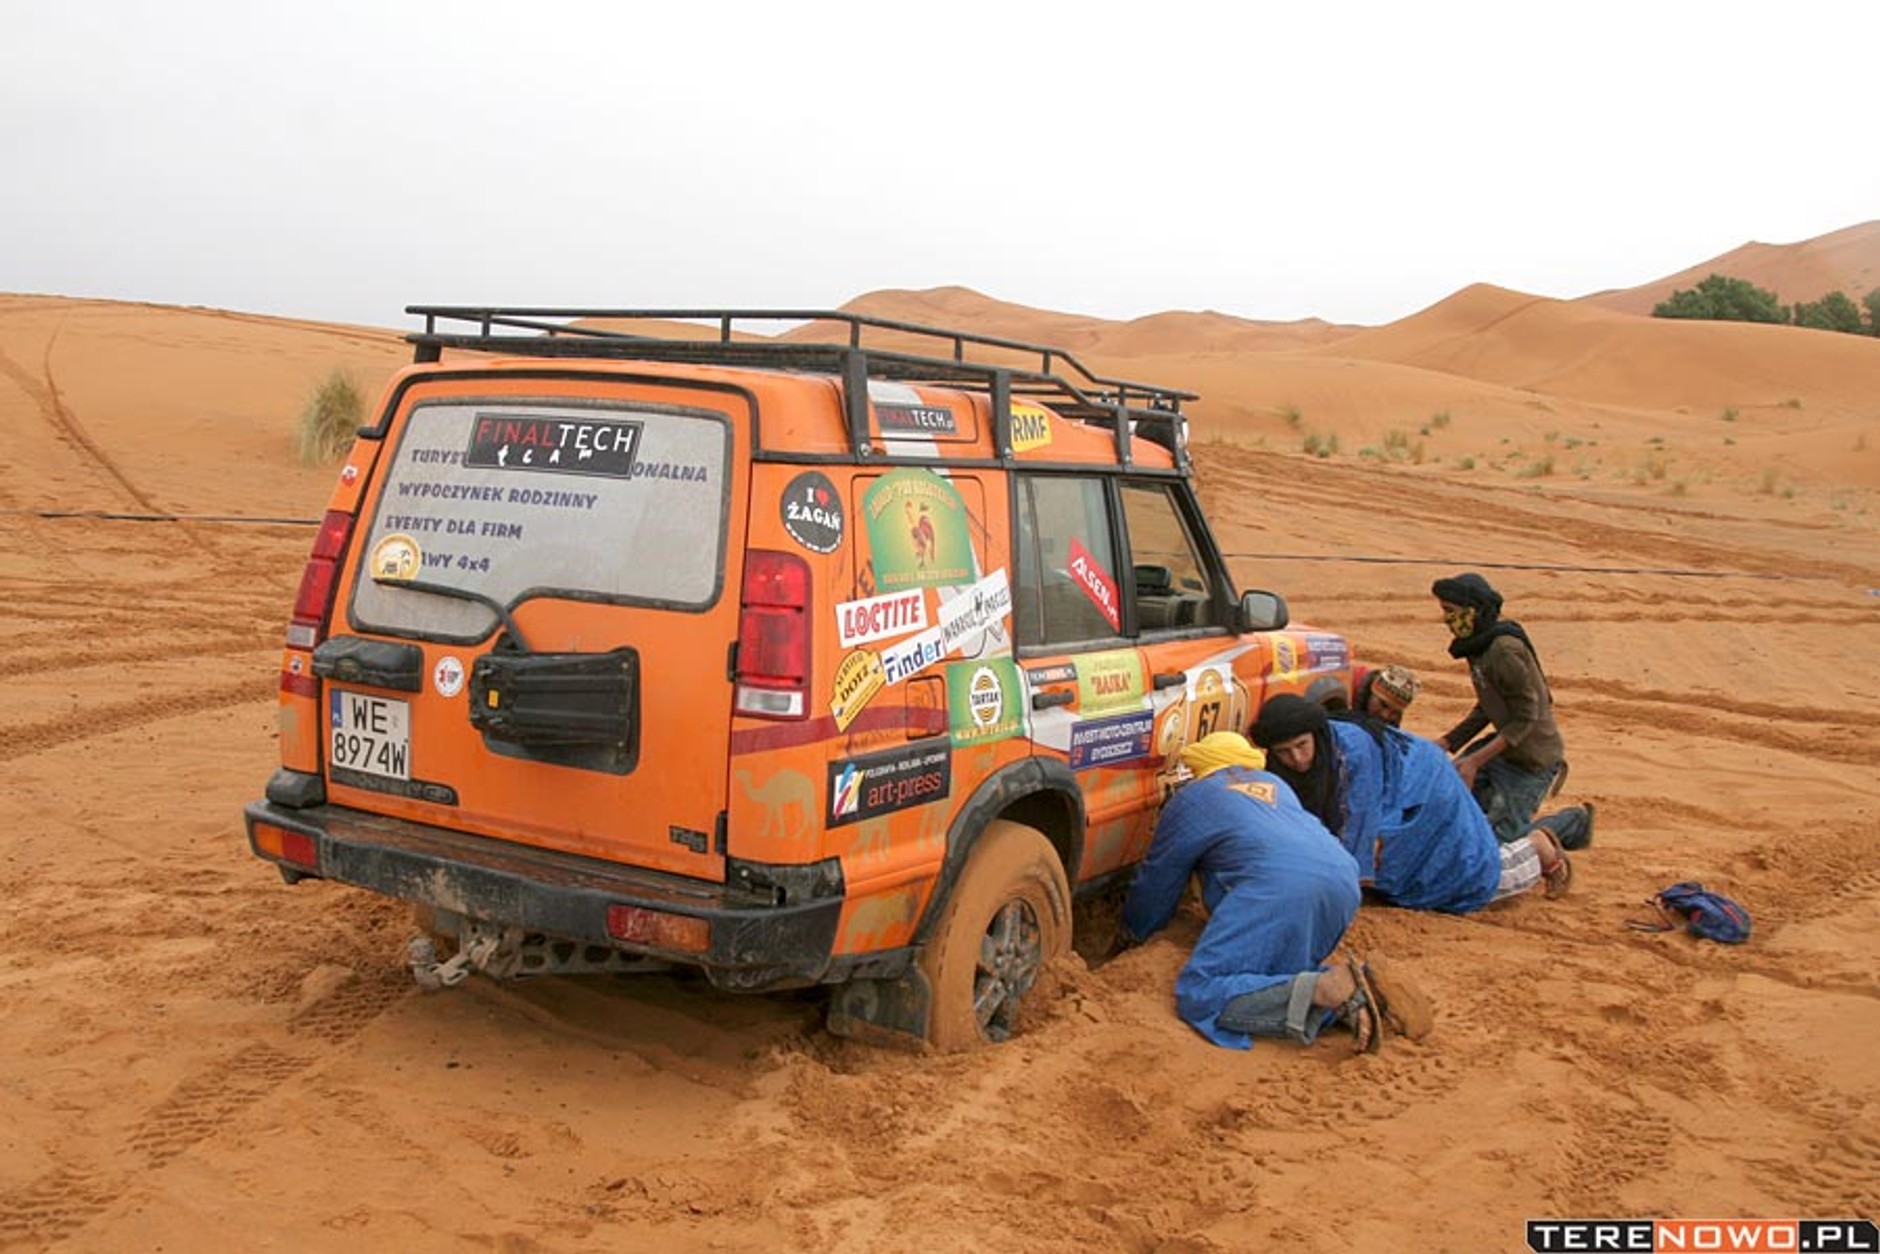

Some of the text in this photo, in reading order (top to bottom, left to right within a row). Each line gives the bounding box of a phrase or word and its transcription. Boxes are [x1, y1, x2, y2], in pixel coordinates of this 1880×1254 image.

[476, 420, 634, 453] FINALTECH
[1013, 414, 1046, 442] RMF
[631, 461, 708, 482] ONALNA
[399, 483, 598, 510] WYPOCZYNEK RODZINNY
[806, 487, 814, 503] I
[385, 515, 523, 540] EVENTY DLA FIRM
[787, 501, 841, 531] ŻAGAŃ
[457, 554, 491, 572] 4x4
[844, 595, 921, 639] LOCTITE
[884, 639, 941, 683] Finder
[353, 697, 388, 735] WE
[1197, 701, 1221, 743] 67
[334, 732, 407, 777] 8974W
[867, 772, 943, 808] art-press
